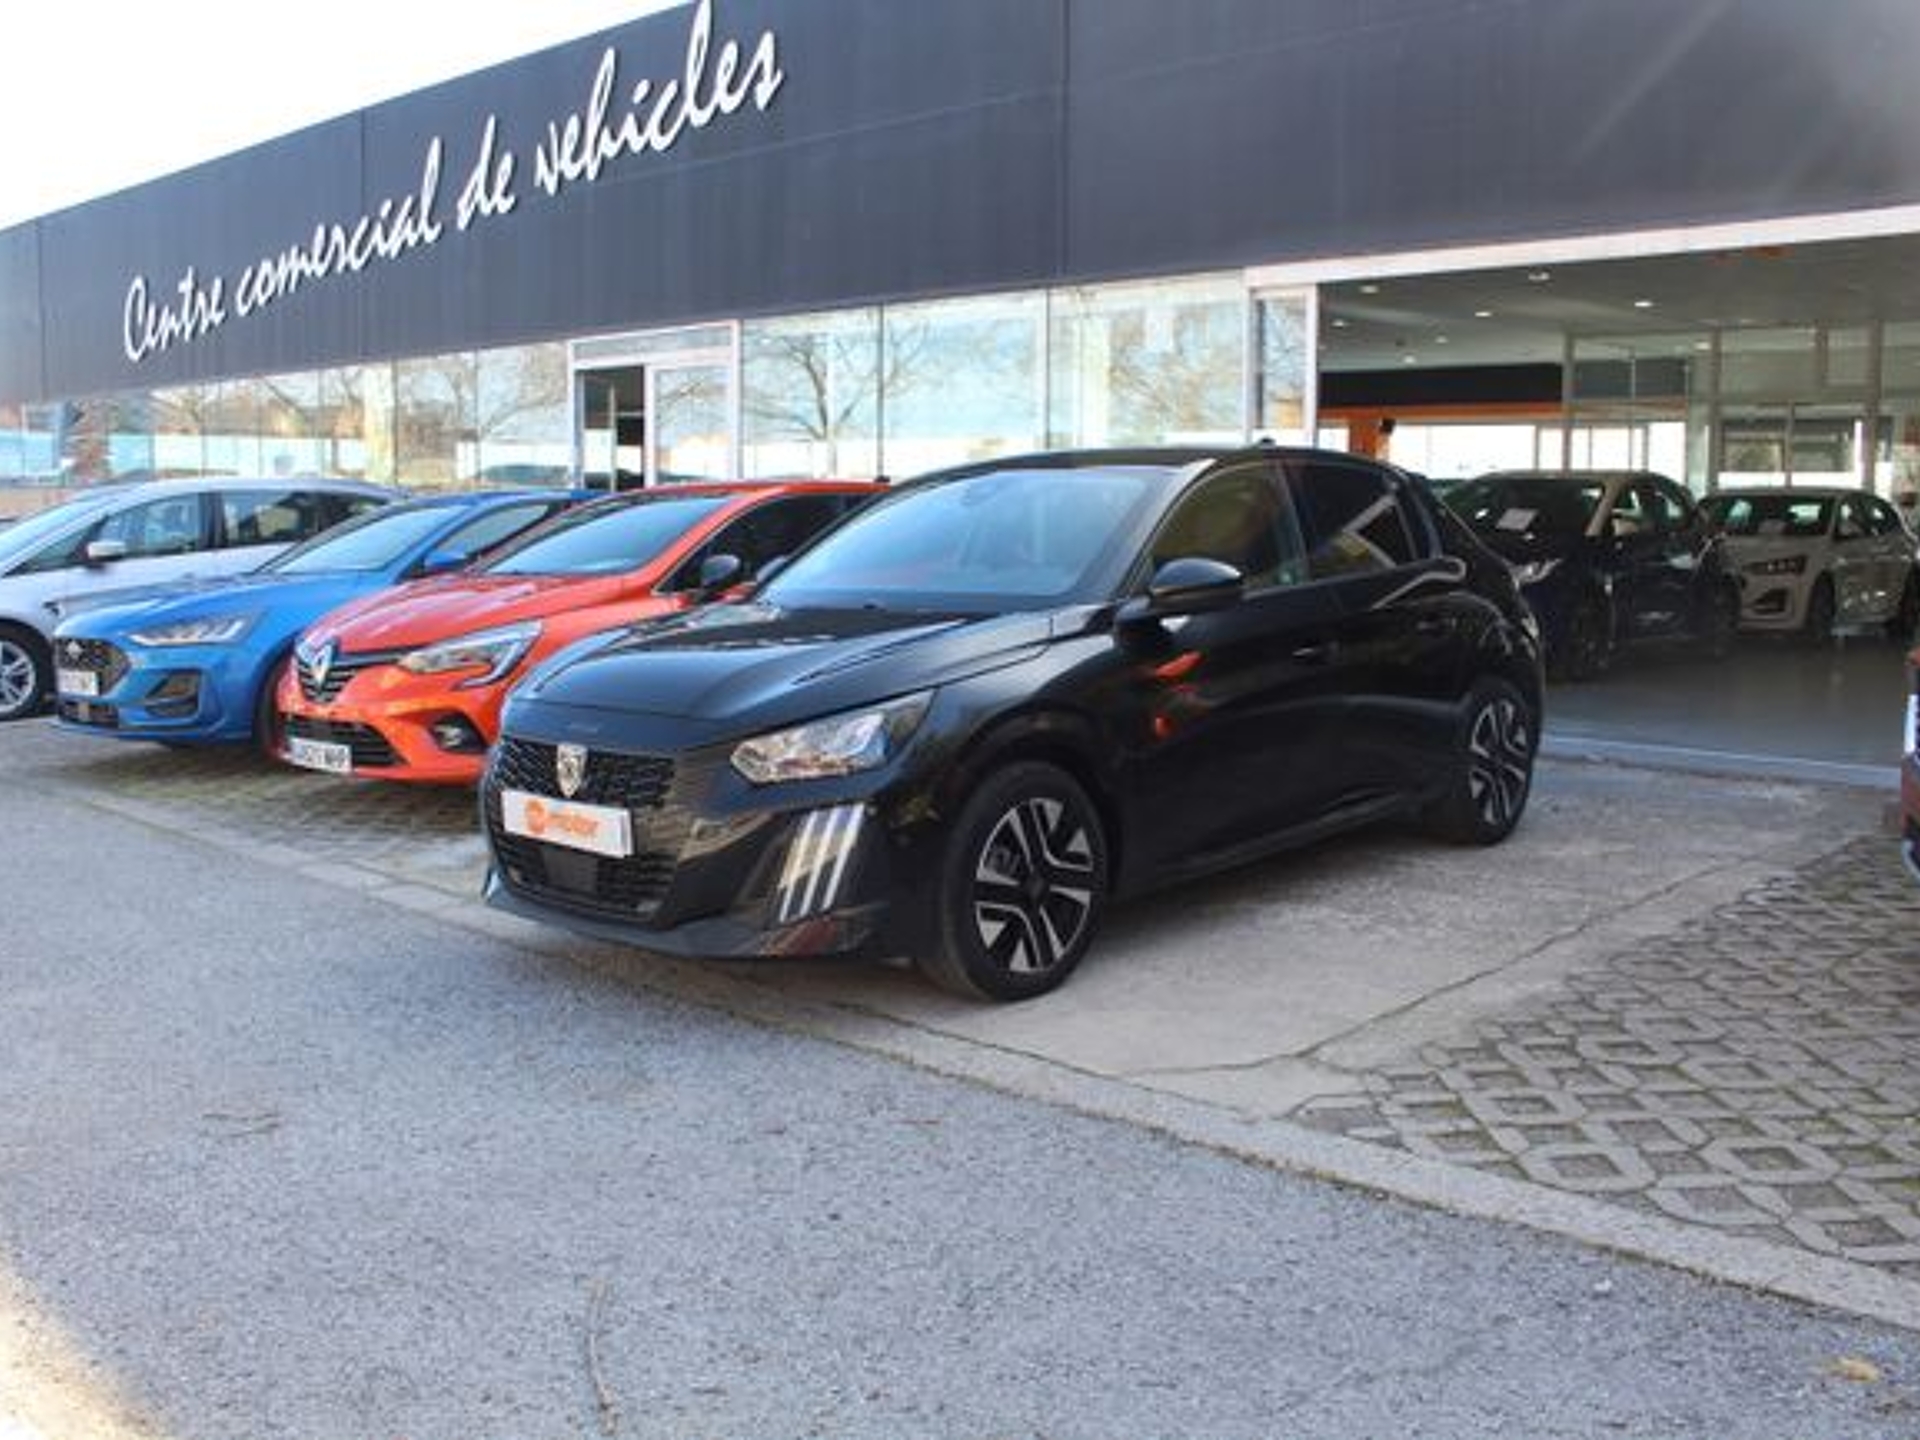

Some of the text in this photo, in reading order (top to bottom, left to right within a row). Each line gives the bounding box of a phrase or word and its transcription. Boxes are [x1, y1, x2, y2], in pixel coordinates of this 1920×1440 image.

[124, 0, 783, 362] Centre comercial de vehicles
